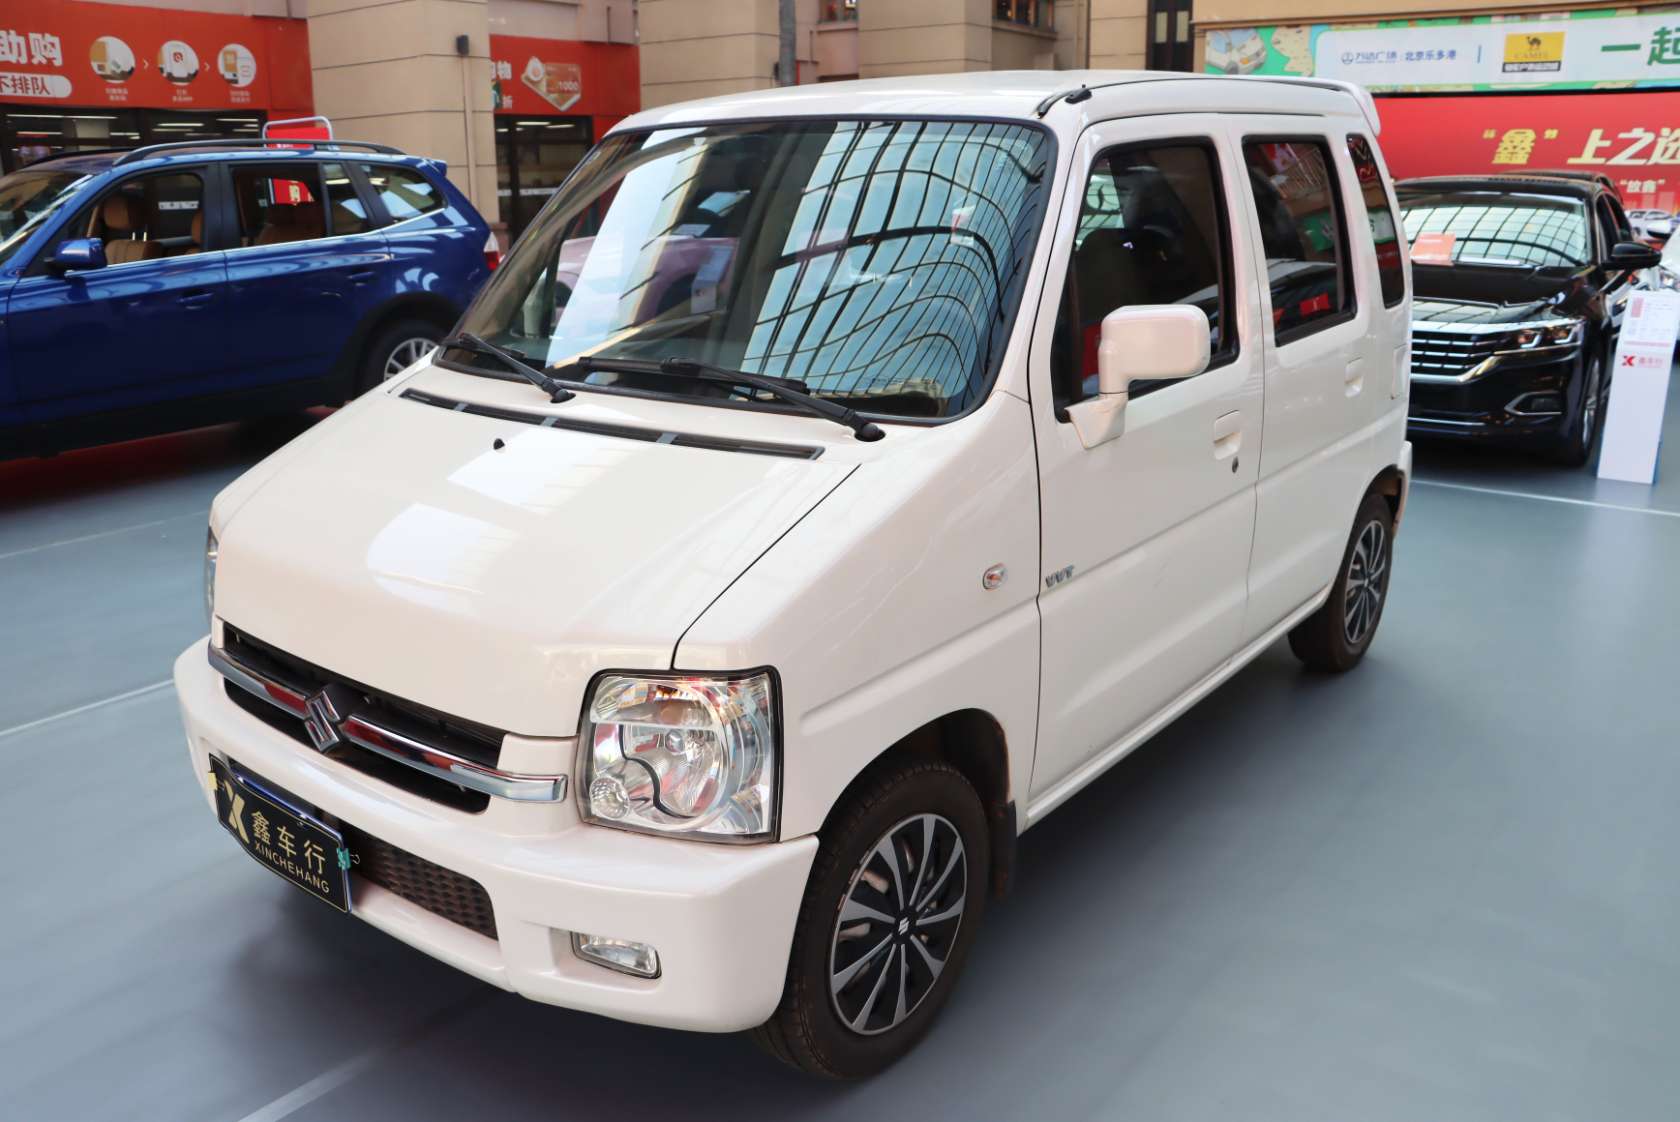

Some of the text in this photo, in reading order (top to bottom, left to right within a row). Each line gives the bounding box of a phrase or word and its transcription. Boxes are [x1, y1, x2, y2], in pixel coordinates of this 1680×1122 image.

[251, 811, 326, 875] 鑫车行
[254, 841, 330, 893] XINCHEHANG
